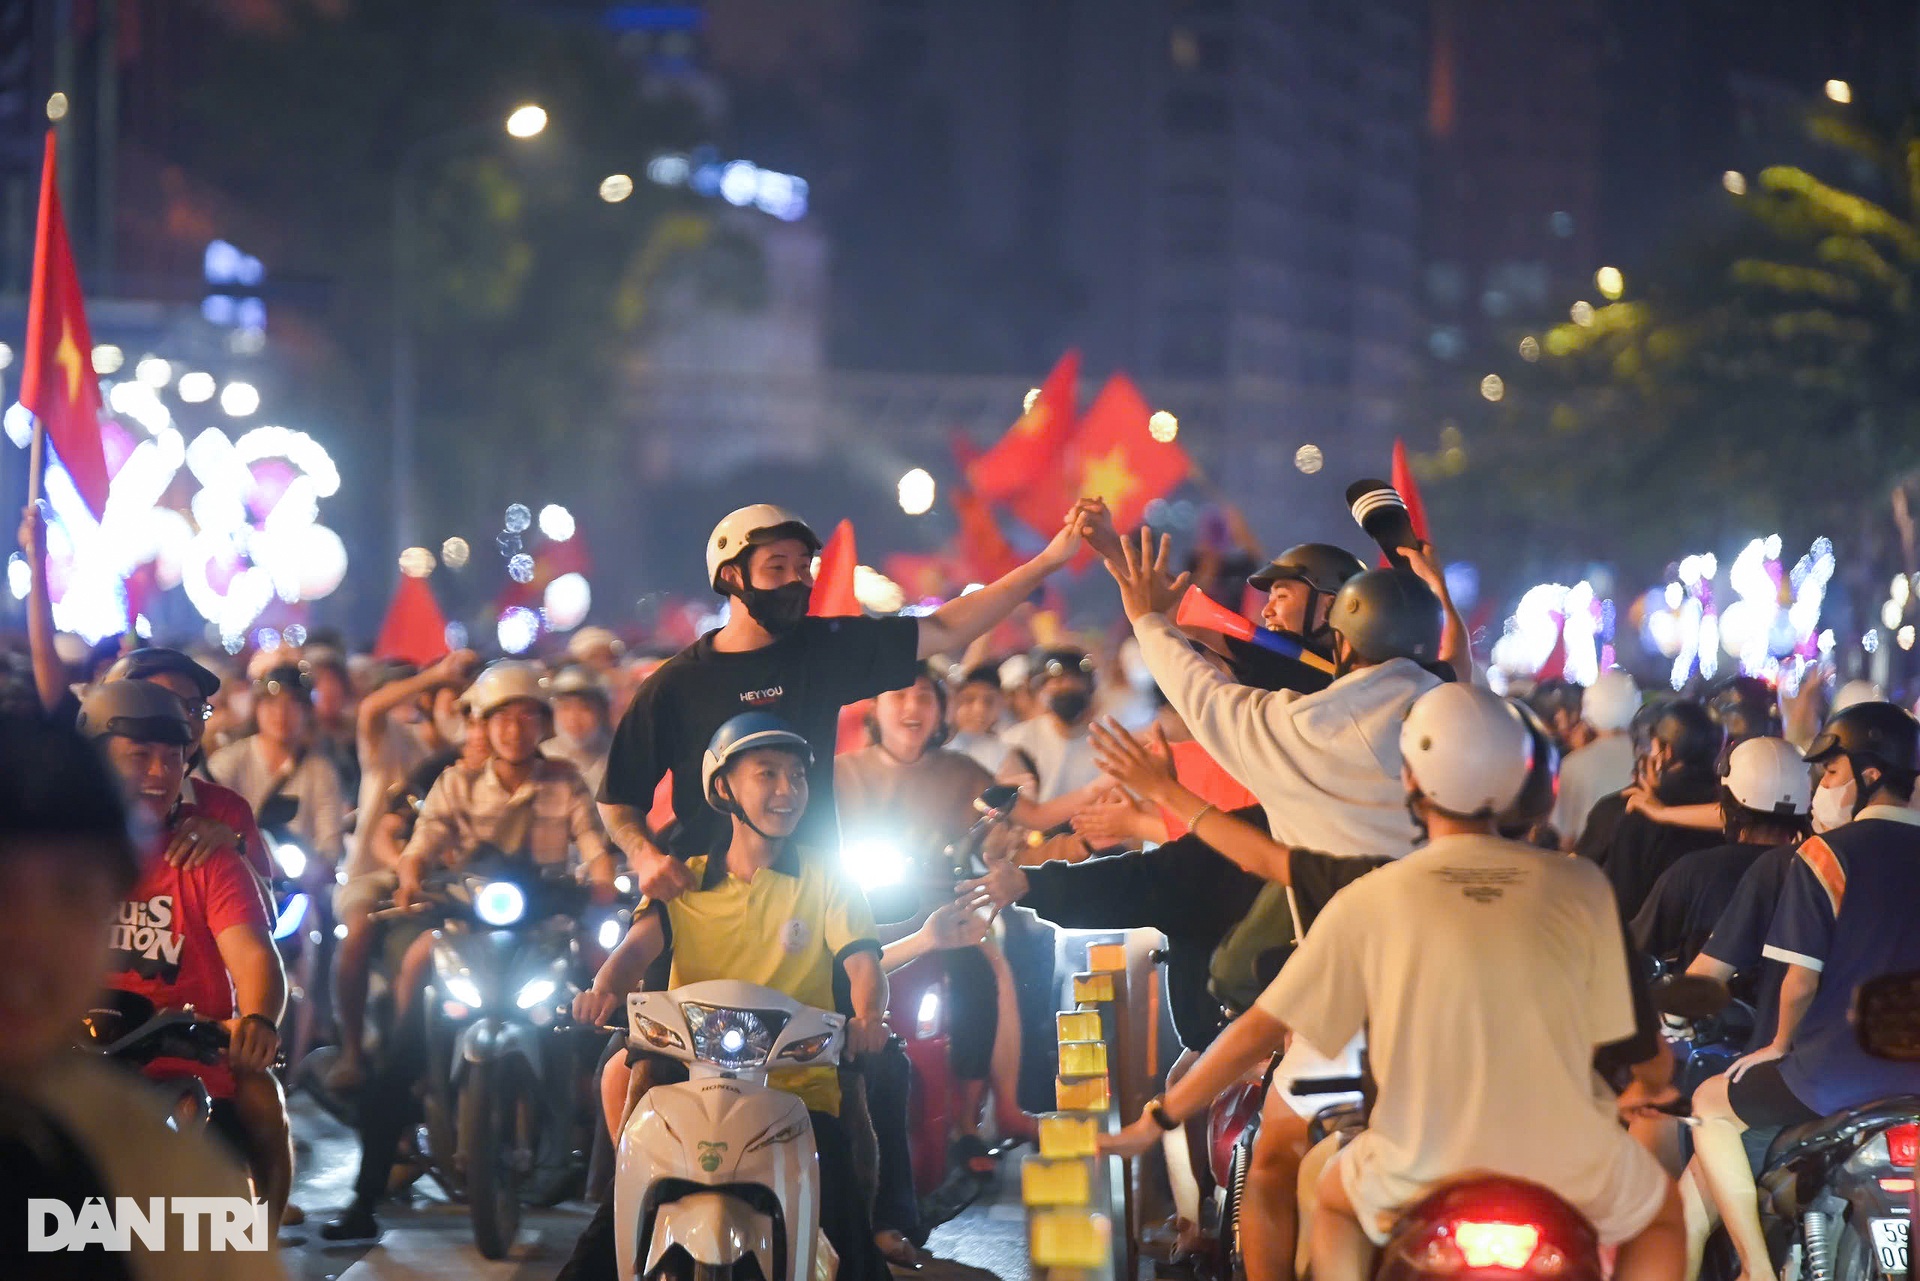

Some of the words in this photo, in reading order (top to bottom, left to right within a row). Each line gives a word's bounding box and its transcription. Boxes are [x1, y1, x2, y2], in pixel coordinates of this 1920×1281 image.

[740, 690, 760, 701] HEY
[761, 686, 783, 698] YOU
[701, 1084, 742, 1094] HONDA
